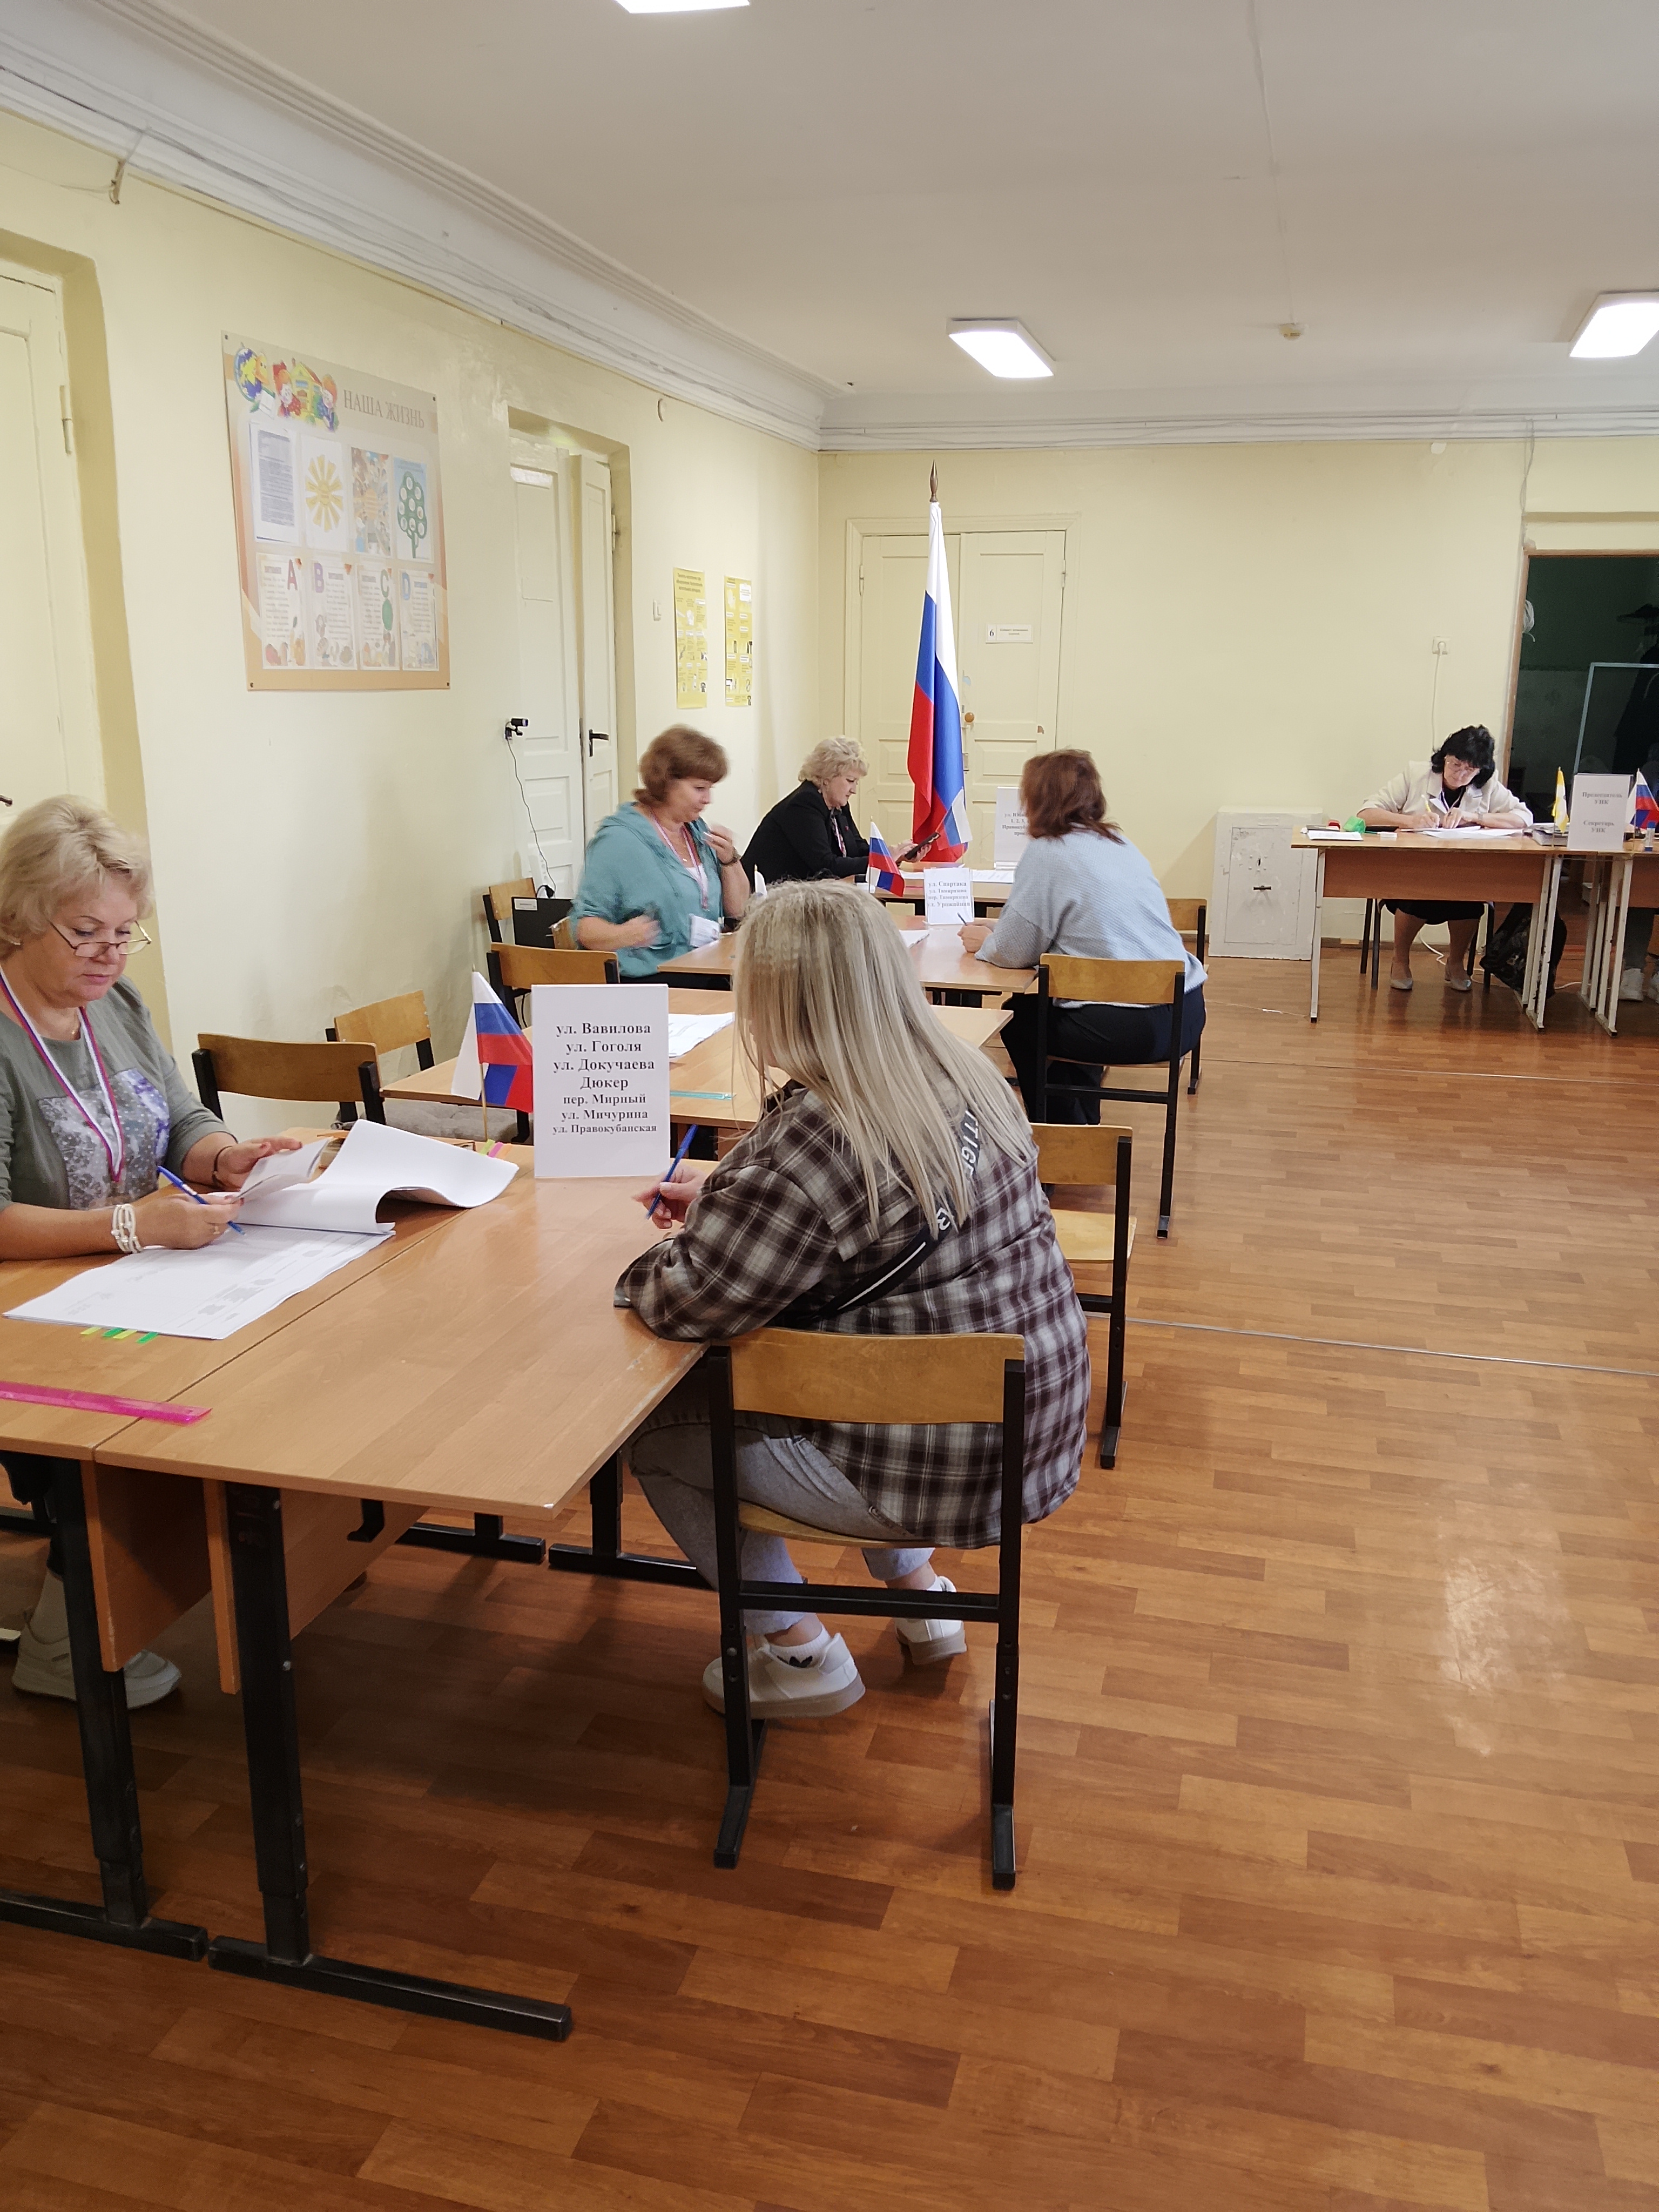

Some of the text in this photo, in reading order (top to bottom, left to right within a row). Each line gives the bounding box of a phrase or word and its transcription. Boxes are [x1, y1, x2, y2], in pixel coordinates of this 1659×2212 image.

[344, 389, 424, 428] НАША ЖИЗНЬ
[556, 1022, 651, 1037] ул. Вавилова
[566, 1041, 642, 1055] ул. Гоголя
[553, 1058, 655, 1073] ул. Докучаева
[579, 1076, 629, 1090] Дюкер
[563, 1094, 646, 1106] пер. Мирный
[561, 1109, 648, 1122] ул. Мичурина
[552, 1124, 657, 1135] ул. Правокубанская
